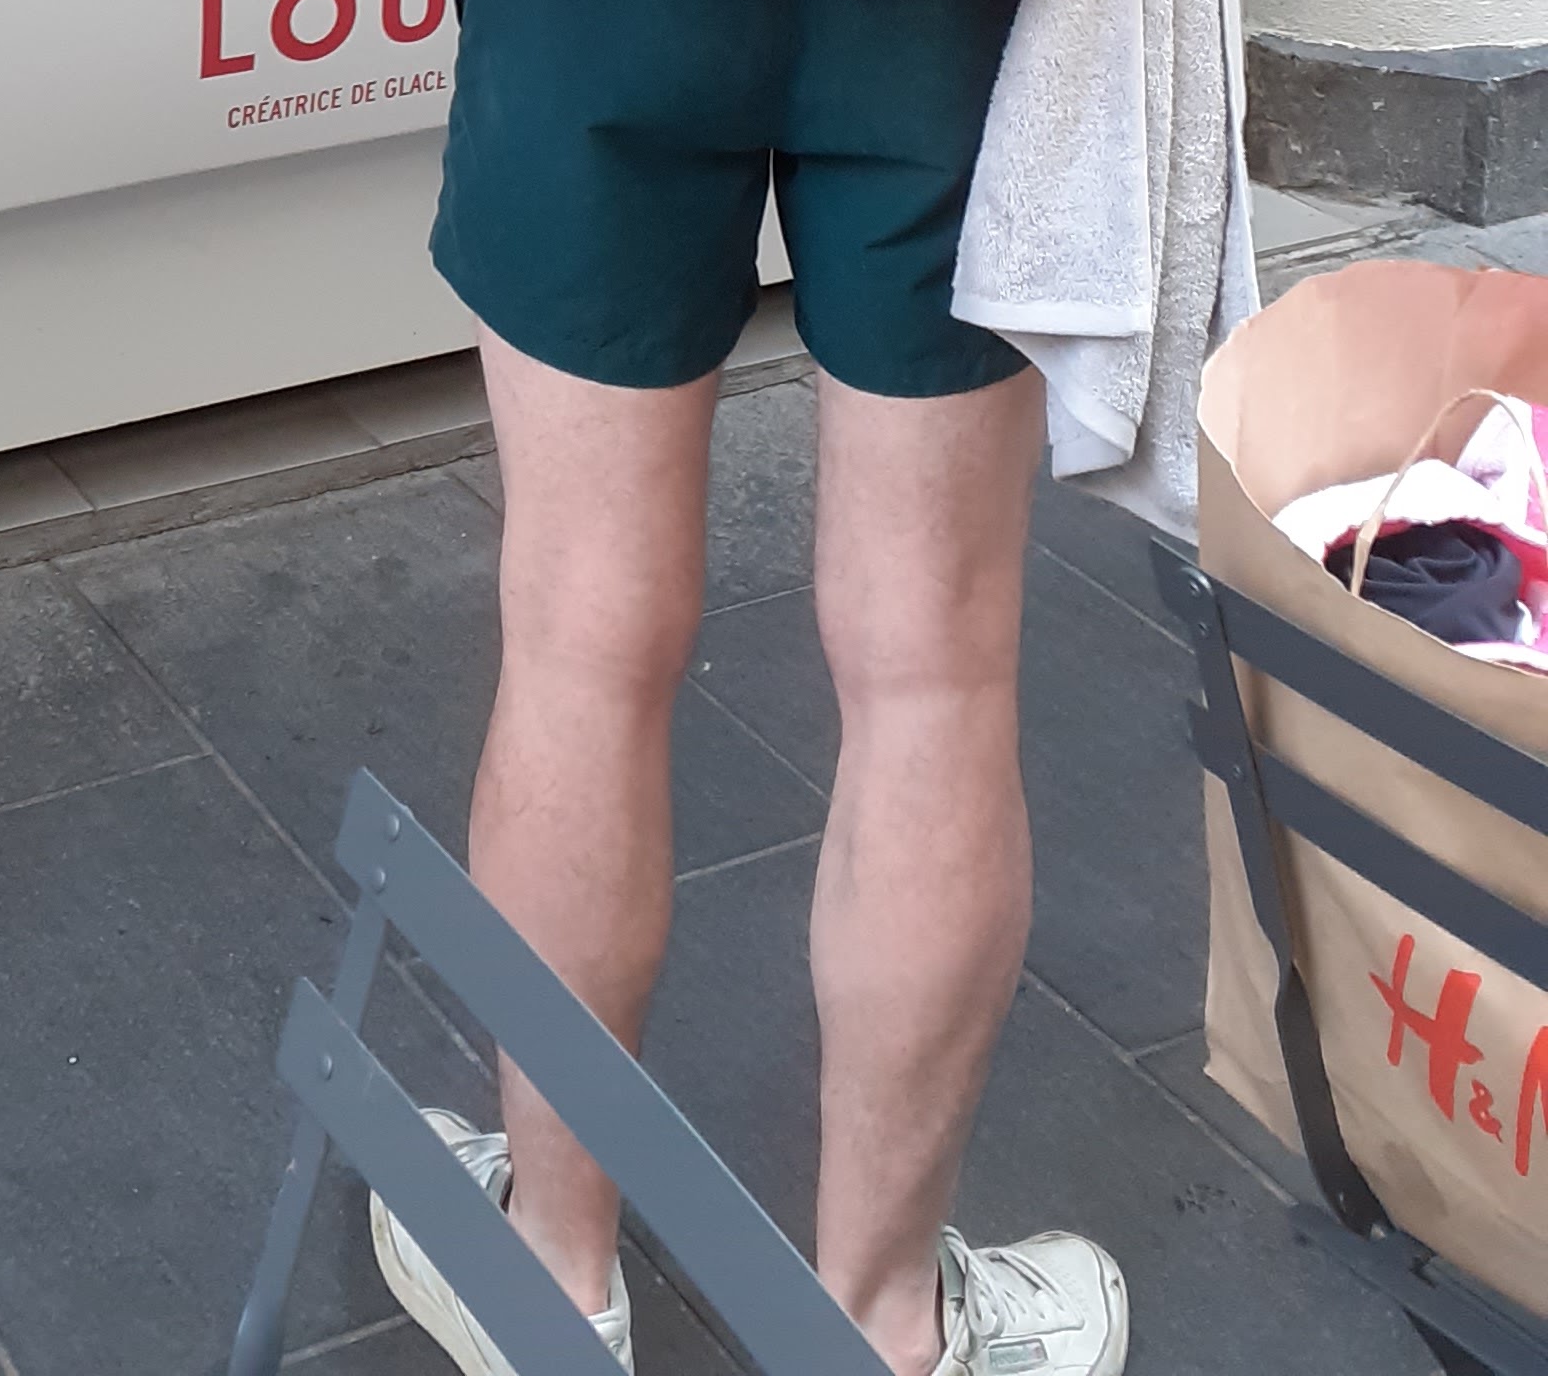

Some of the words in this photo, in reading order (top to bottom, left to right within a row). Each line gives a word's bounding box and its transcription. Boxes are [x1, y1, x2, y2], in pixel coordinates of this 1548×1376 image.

[227, 86, 343, 129] CRÉATRICE
[351, 80, 377, 105] DE
[384, 70, 448, 98] GLACE
